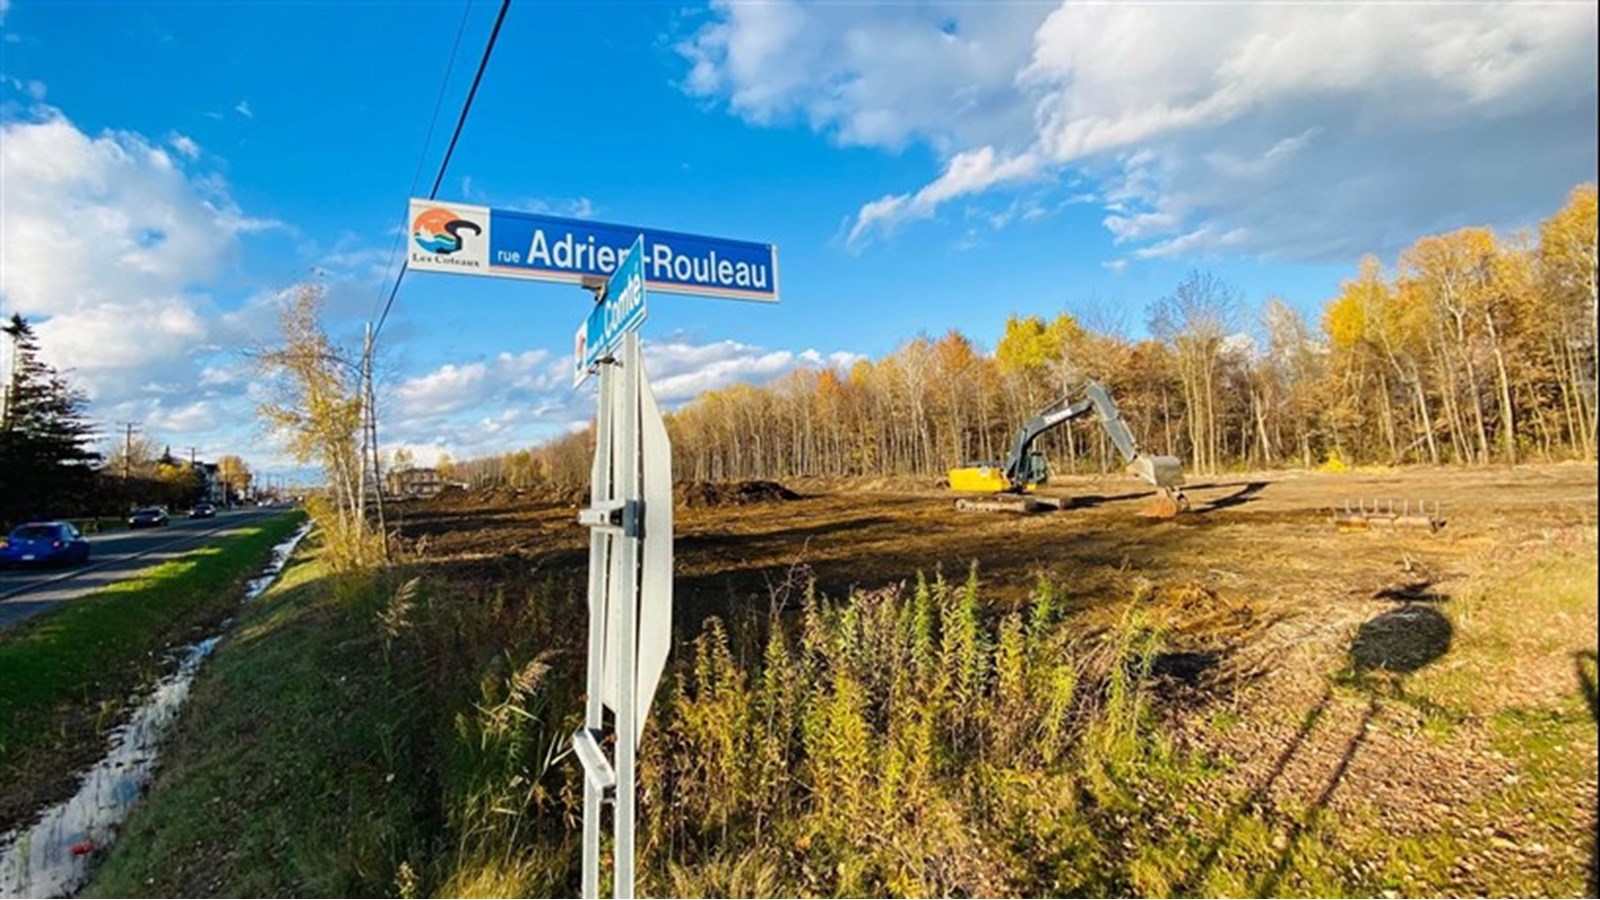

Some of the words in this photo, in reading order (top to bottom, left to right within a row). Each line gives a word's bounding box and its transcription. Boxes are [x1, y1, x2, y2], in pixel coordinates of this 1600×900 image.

[412, 252, 432, 264] Les
[435, 252, 480, 267] Coteaux
[497, 249, 521, 263] rue
